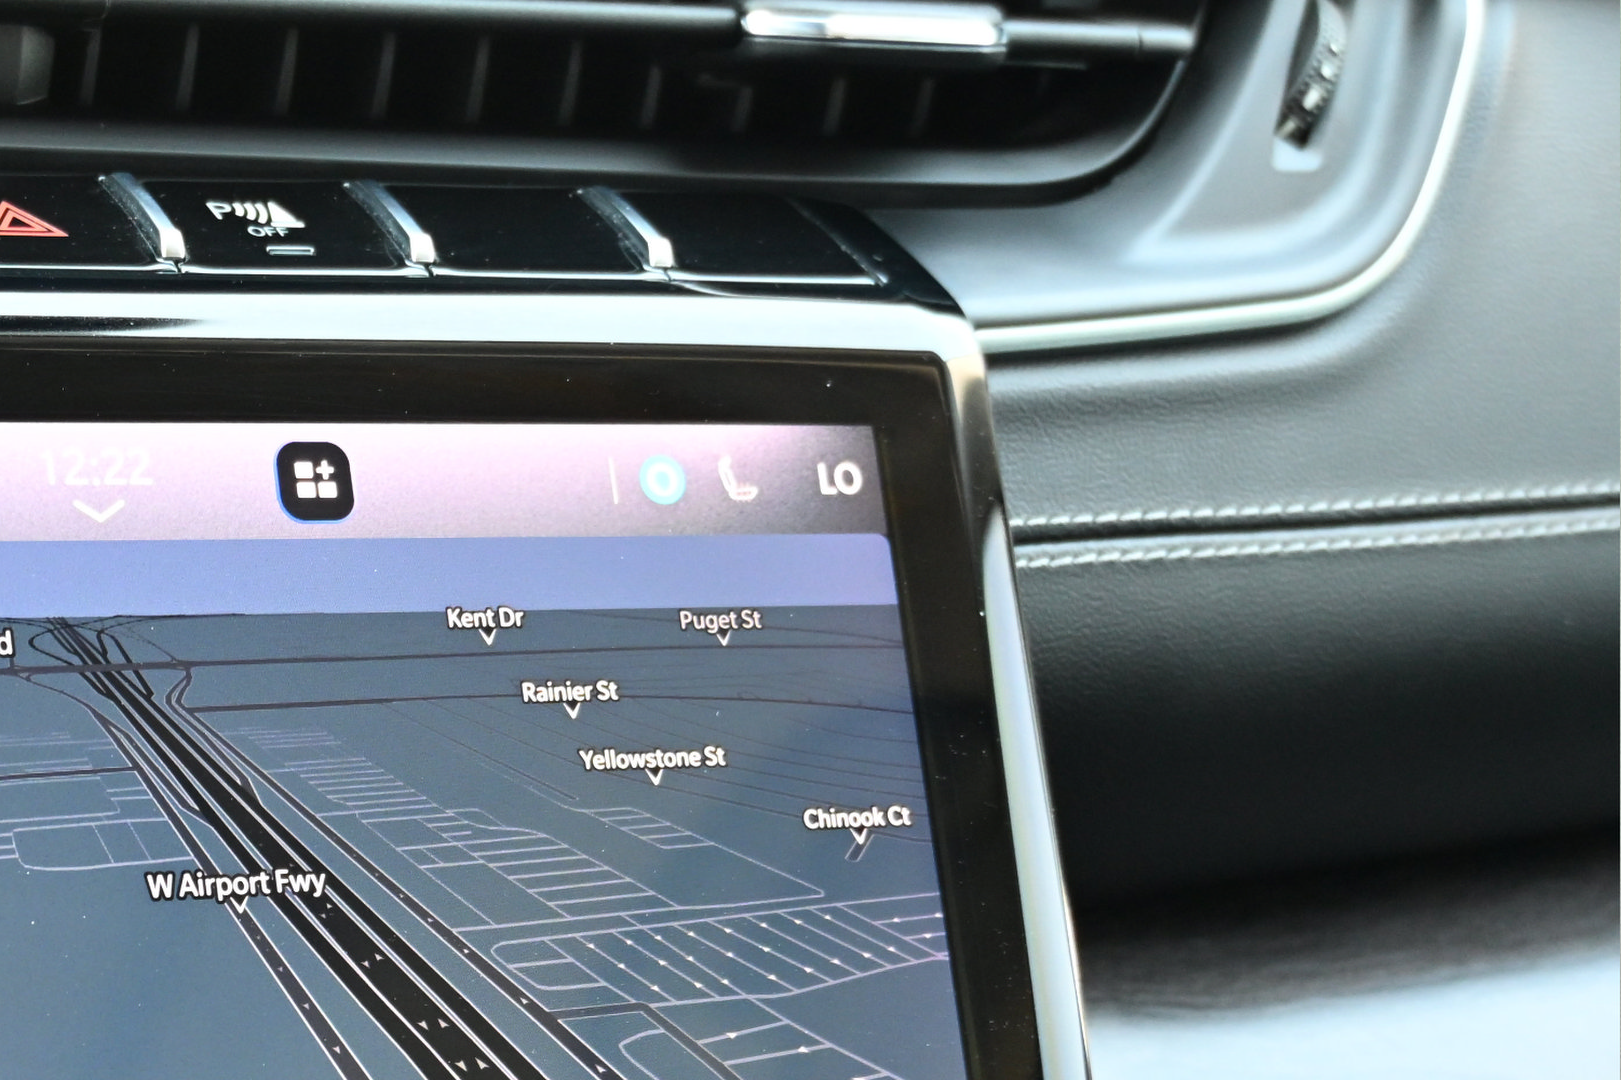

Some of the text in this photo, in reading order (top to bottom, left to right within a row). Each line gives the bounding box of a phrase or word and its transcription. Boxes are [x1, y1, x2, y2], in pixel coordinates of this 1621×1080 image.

[247, 225, 289, 237] OFF
[40, 446, 155, 486] 12:22
[817, 461, 863, 495] LO
[446, 606, 524, 628] Kent Dr
[679, 609, 762, 634] Puget St
[522, 679, 619, 702] Rainier St
[579, 746, 726, 770] Yellowstone St
[803, 805, 912, 829] Chinook Ct
[146, 869, 326, 902] W Airport Fwy
